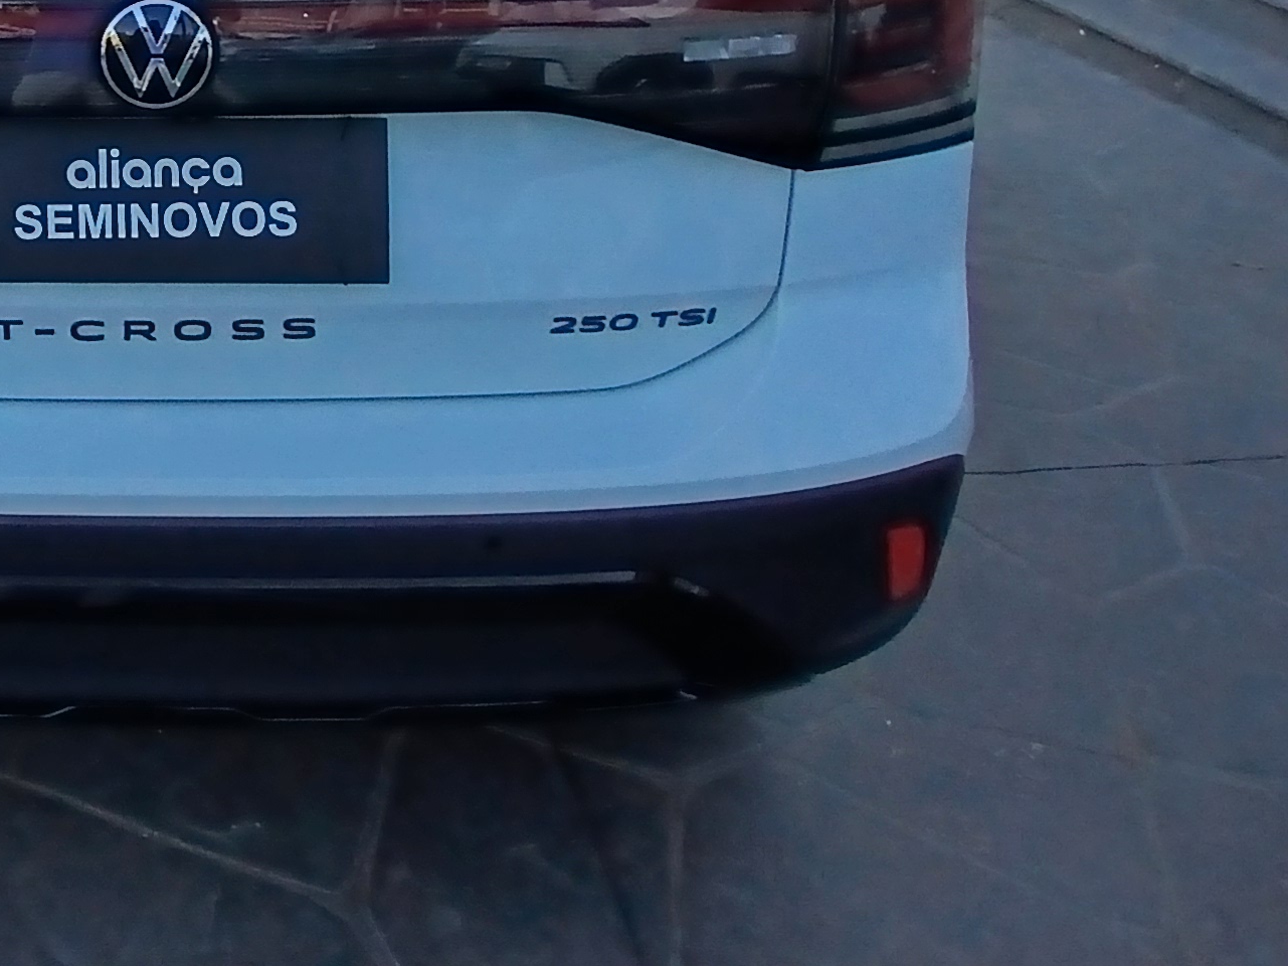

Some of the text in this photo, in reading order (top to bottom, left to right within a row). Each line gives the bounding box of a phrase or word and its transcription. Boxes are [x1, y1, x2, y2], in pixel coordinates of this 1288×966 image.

[66, 148, 243, 194] aliança
[14, 201, 298, 240] SEMINOVOS
[549, 307, 716, 334] 250 TSI
